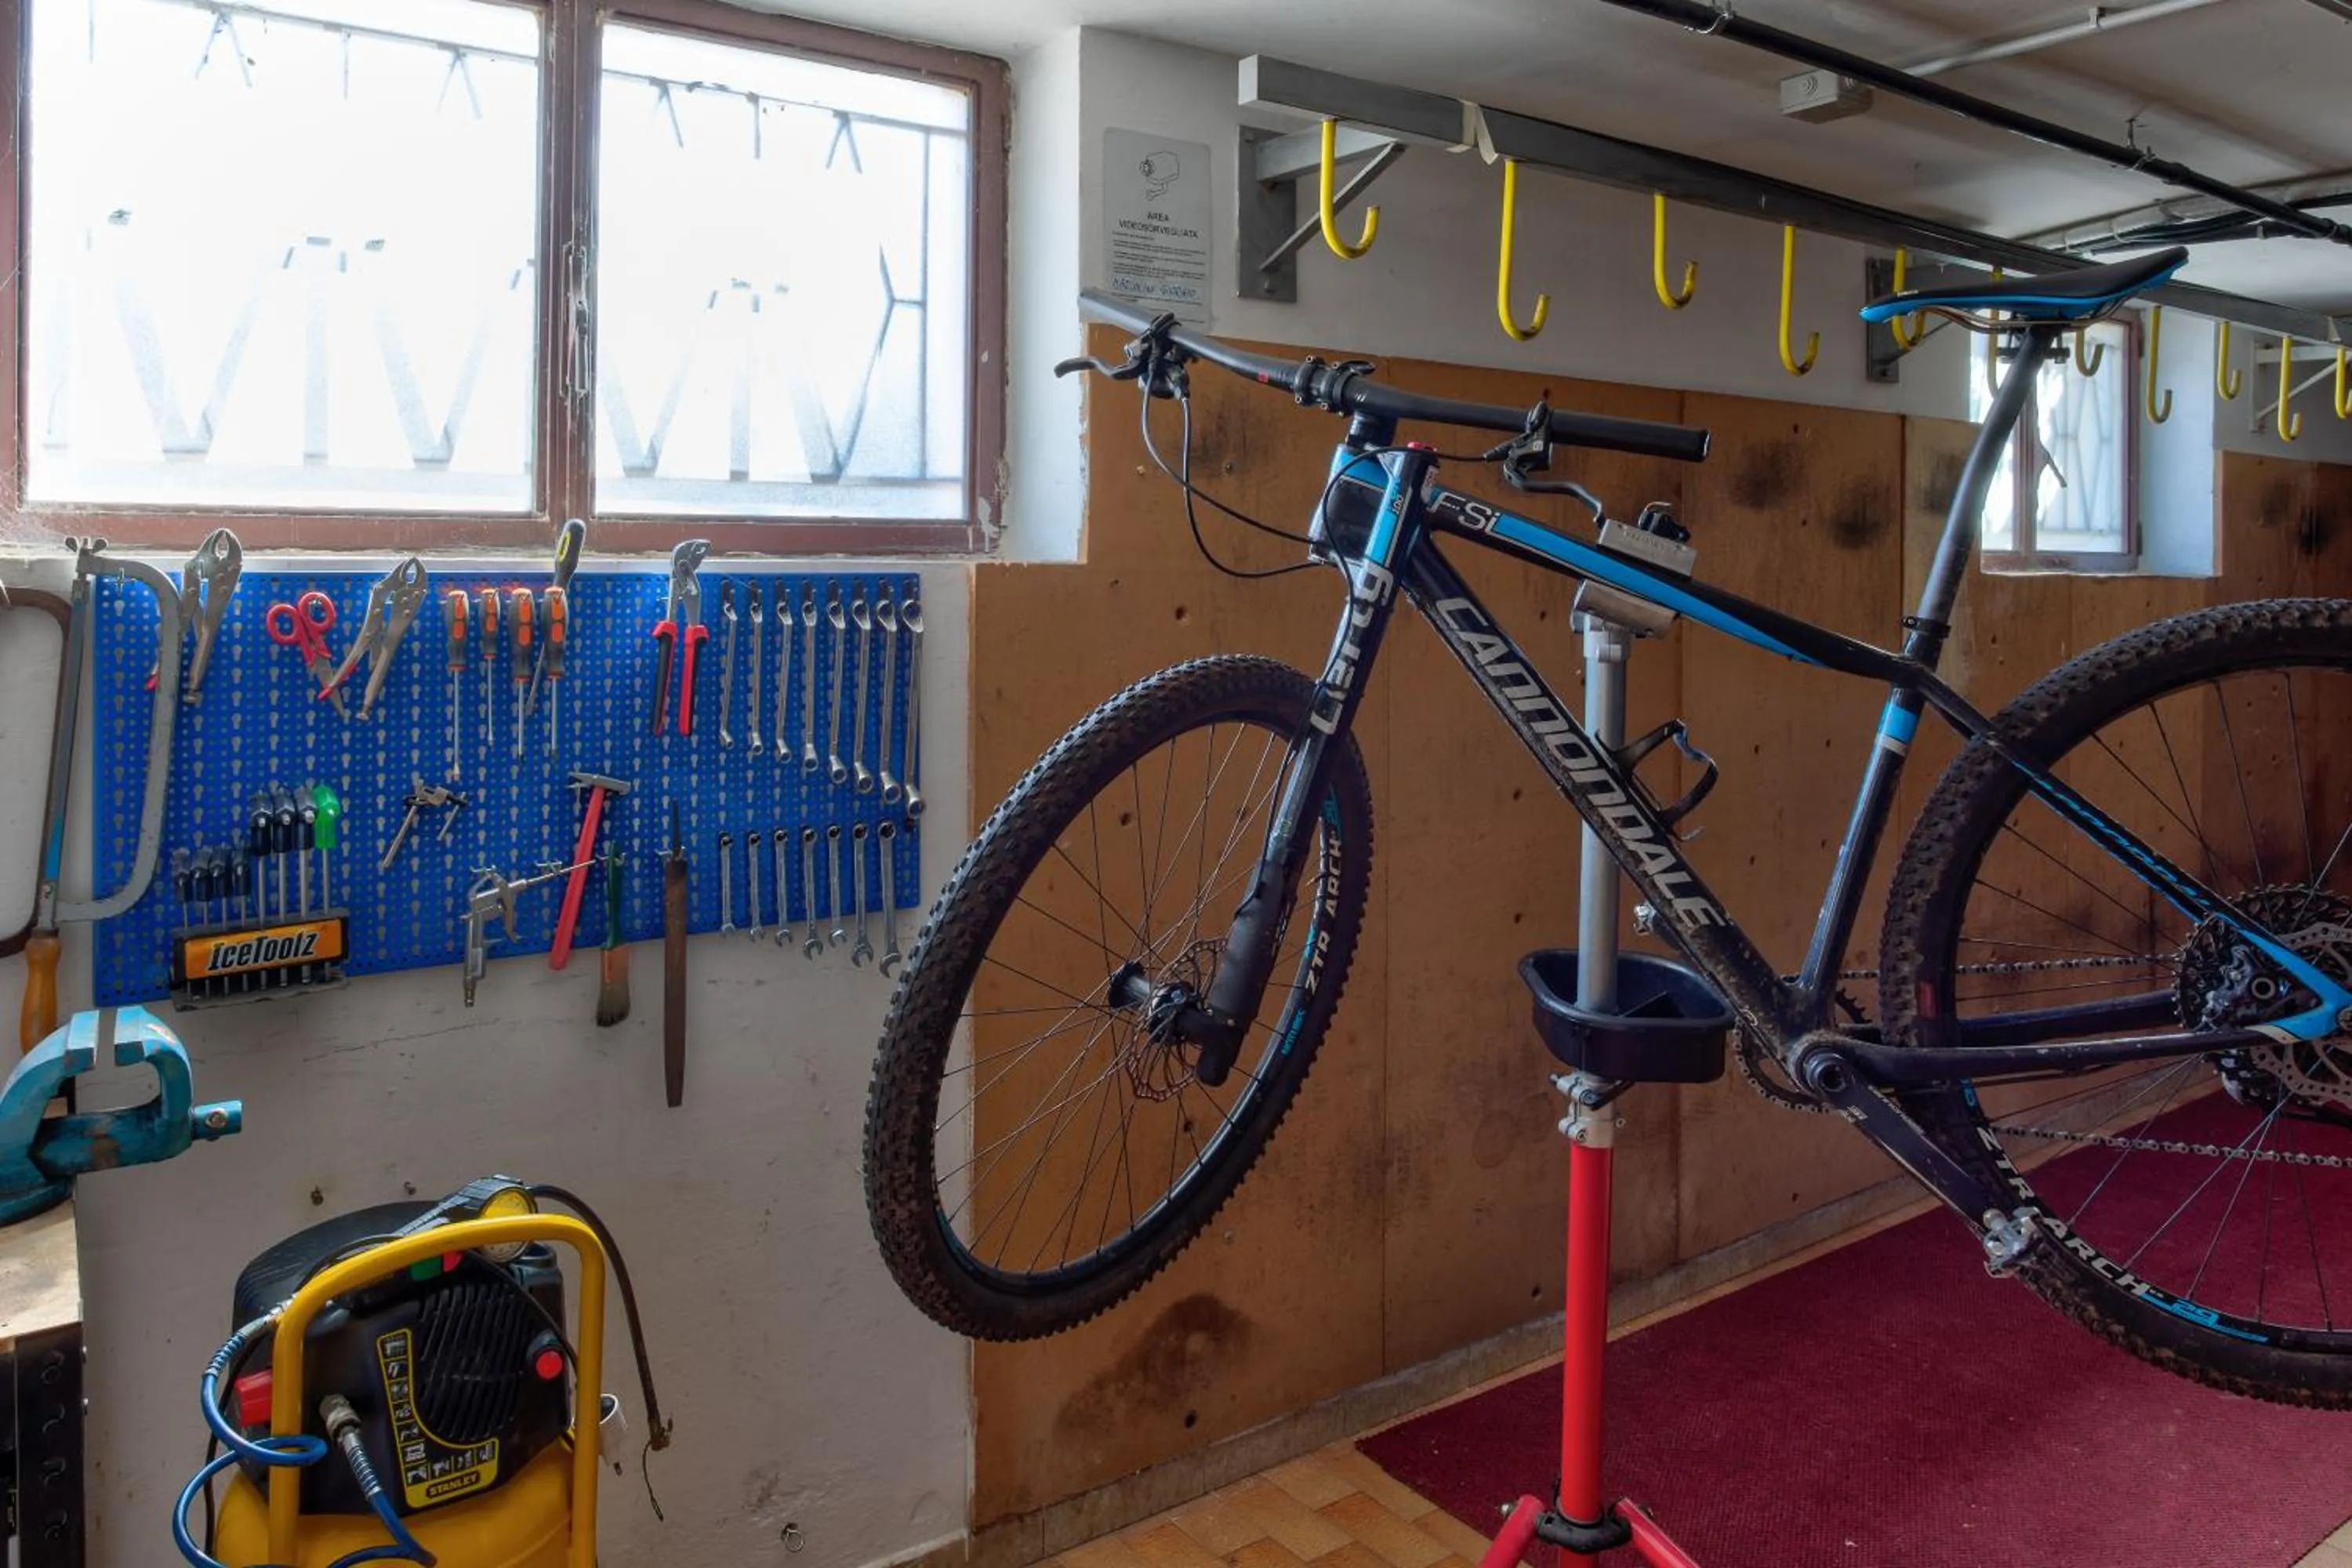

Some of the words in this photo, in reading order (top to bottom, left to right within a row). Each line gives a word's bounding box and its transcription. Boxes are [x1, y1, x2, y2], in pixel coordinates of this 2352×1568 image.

[1425, 492, 1501, 535] FSi
[1325, 835, 1342, 917] ARCH
[207, 932, 318, 971] IceToolz
[2042, 1217, 2151, 1296] ARCH
[428, 1473, 478, 1496] STANLEY
